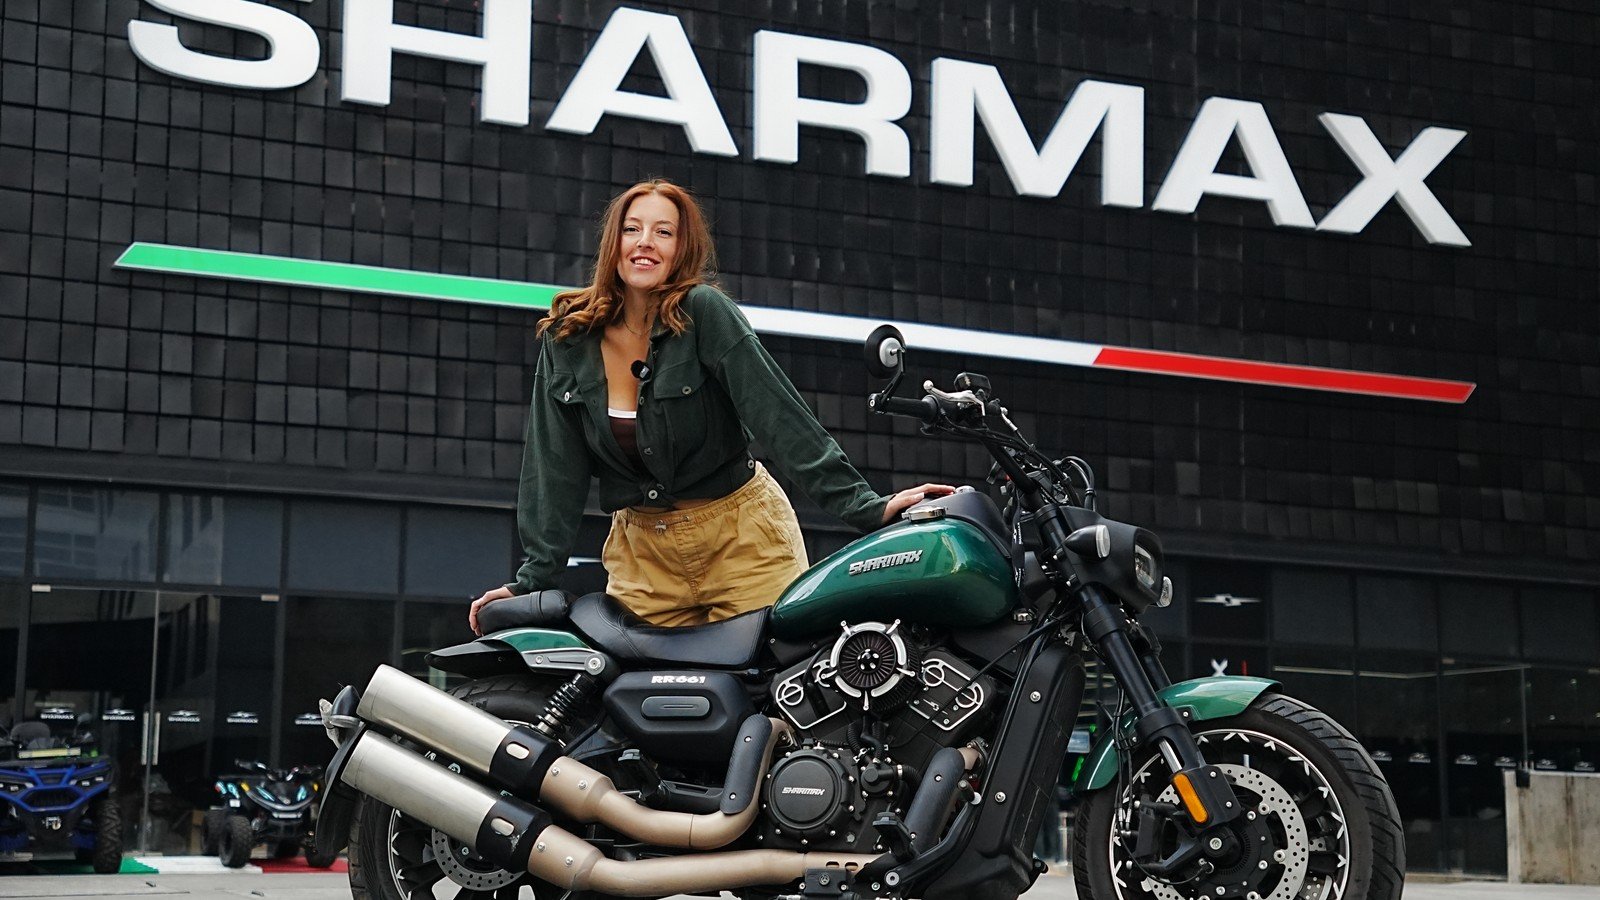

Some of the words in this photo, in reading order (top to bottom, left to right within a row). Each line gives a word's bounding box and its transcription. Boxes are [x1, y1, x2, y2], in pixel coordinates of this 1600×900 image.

[128, 0, 1472, 247] SHARMAX
[849, 550, 923, 576] SHARMAX
[651, 675, 706, 684] RR661
[782, 787, 825, 796] SHARMAX
